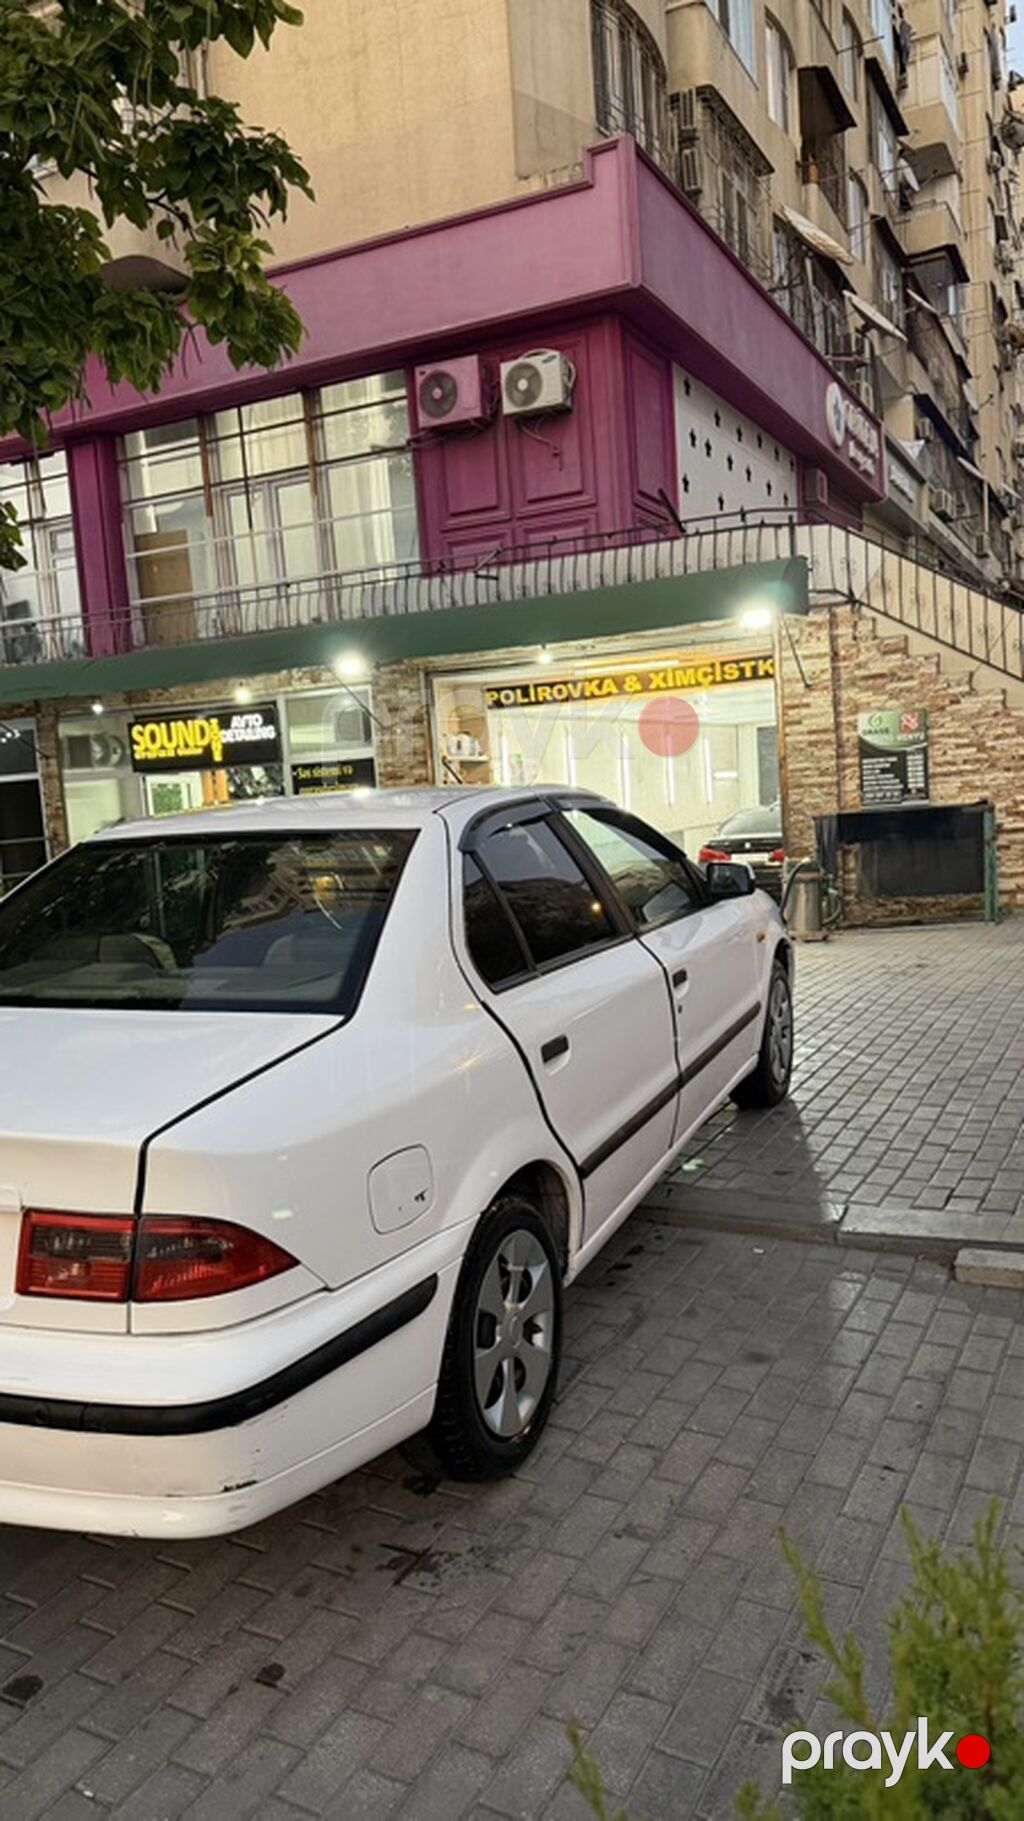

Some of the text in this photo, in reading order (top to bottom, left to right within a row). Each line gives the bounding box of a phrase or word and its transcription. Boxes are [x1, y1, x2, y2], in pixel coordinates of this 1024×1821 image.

[486, 678, 619, 706] POLİROVKA
[623, 675, 642, 692] &
[131, 719, 210, 751] SOUND
